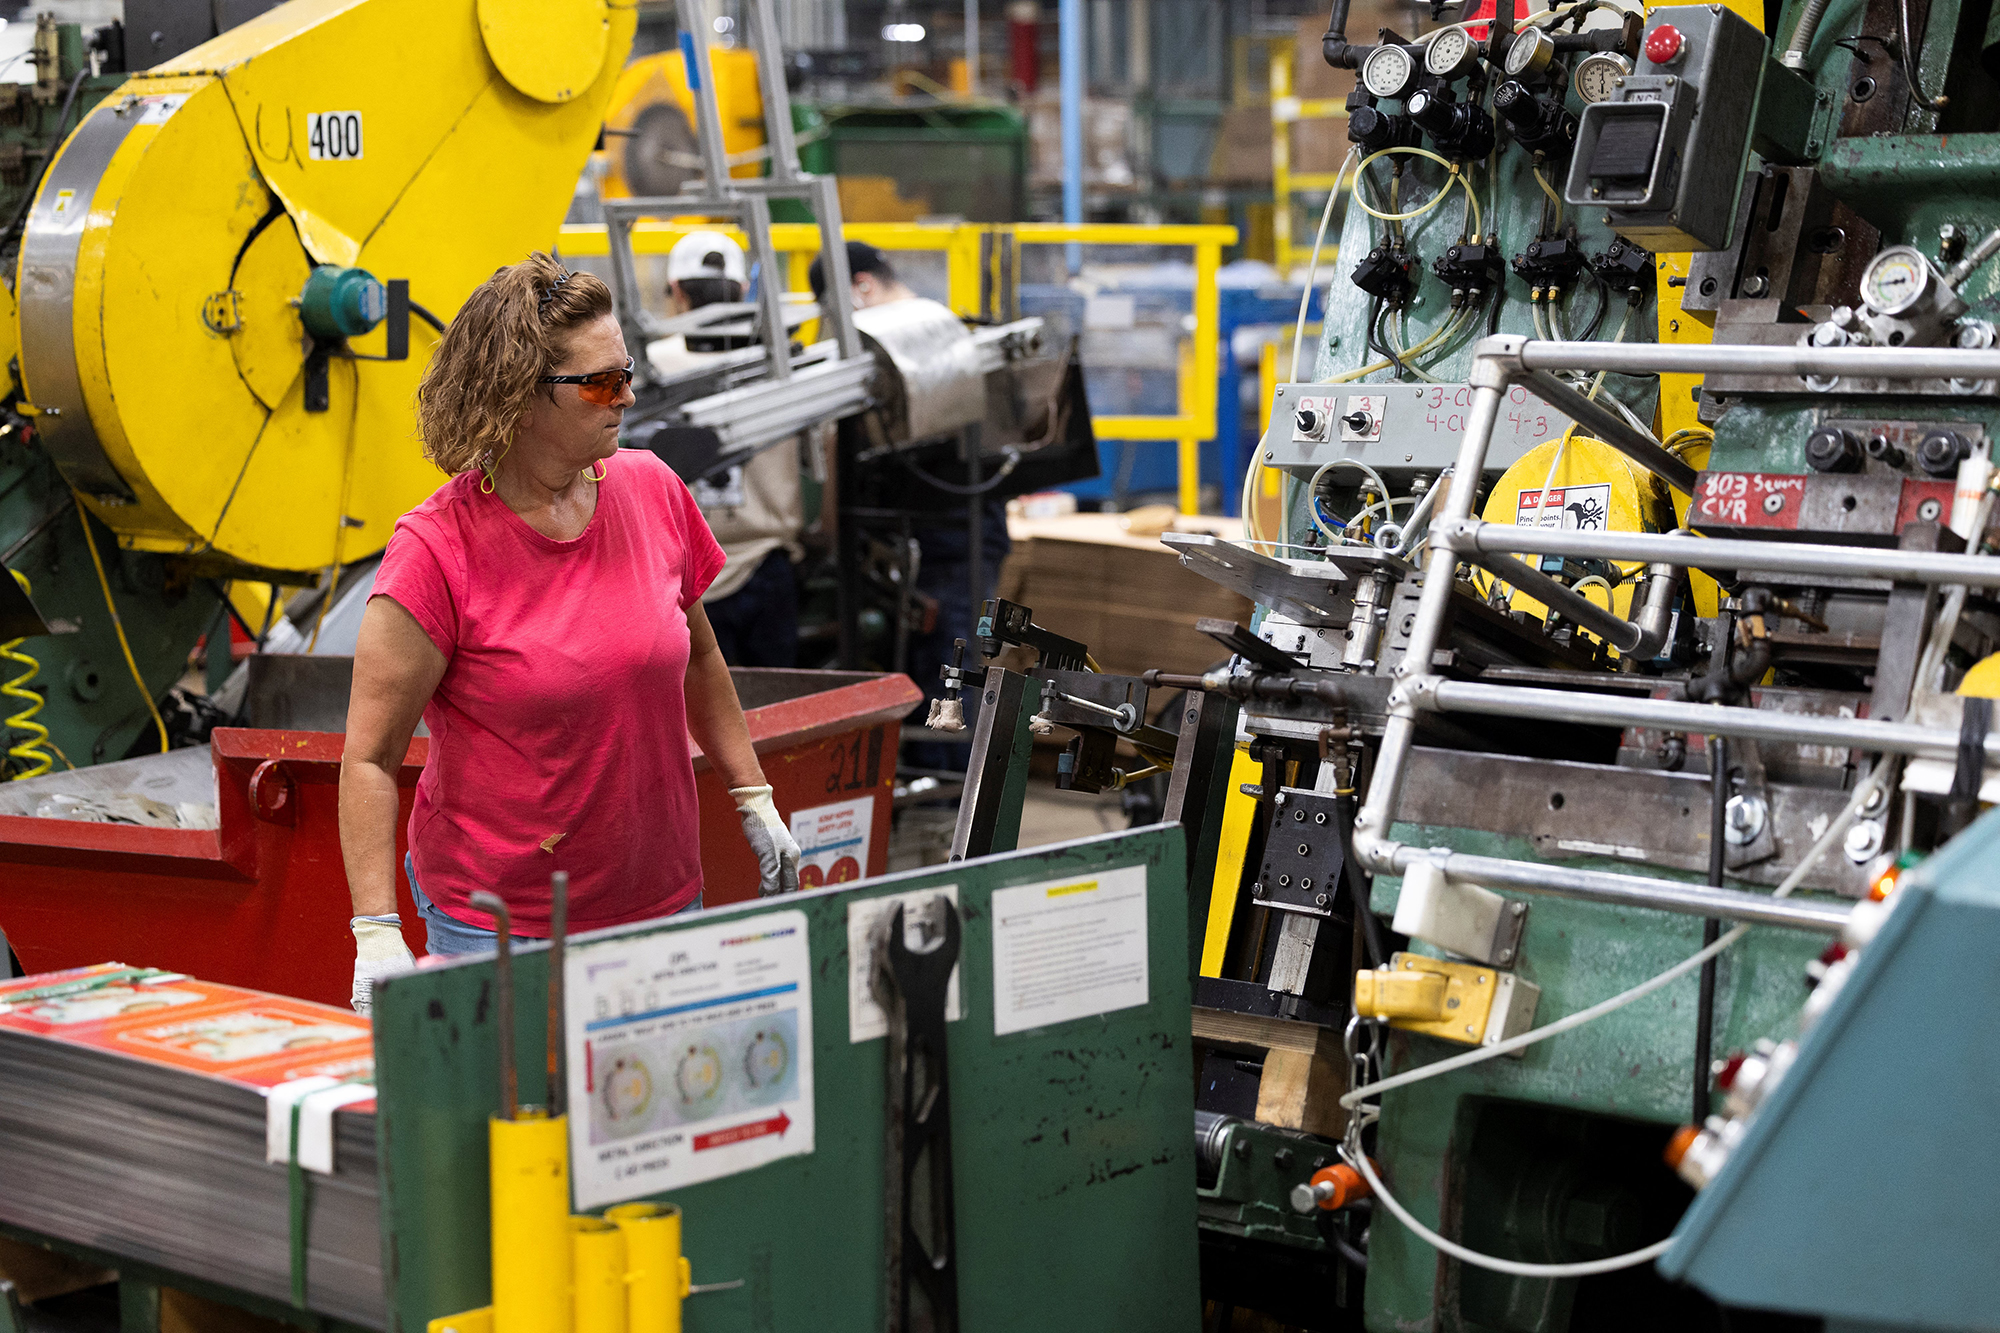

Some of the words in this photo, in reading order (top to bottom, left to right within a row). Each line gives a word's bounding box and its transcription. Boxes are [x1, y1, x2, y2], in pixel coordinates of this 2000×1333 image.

[311, 113, 359, 158] 400
[1360, 396, 1371, 412] 3
[1371, 420, 1382, 436] 5
[1509, 411, 1548, 437] 4-3
[1533, 495, 1561, 503] DGER
[1705, 473, 1748, 499] 803
[1701, 497, 1747, 525] CVR
[826, 730, 863, 794] 21
